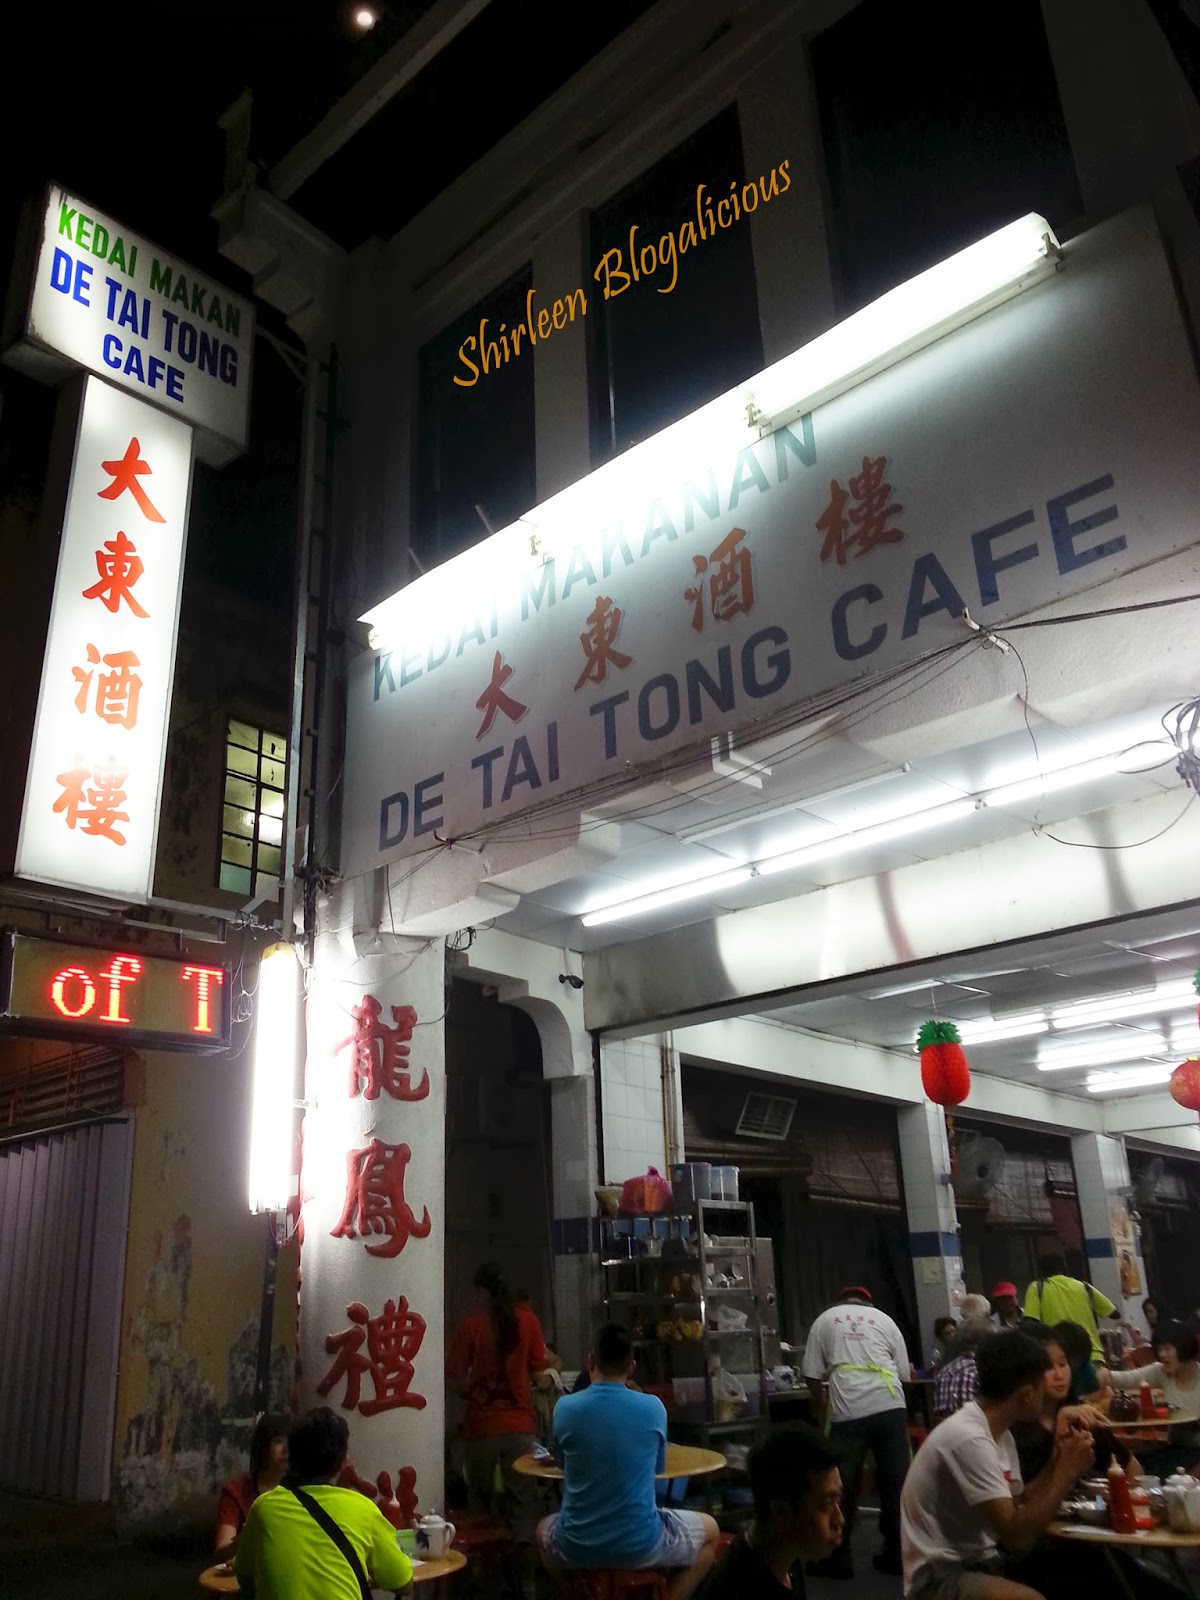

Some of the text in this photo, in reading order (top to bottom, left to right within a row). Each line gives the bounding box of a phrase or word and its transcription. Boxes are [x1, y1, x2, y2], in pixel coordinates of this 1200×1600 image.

[50, 246, 239, 388] DE TAI TONG
[58, 202, 241, 338] KEDAI MAKAN
[102, 333, 185, 404] CAFE
[51, 436, 167, 847] 大東酒樓
[373, 411, 818, 702] KEDAI MAKANAN
[379, 473, 1128, 852] DE TAI TONG CAFE
[475, 456, 905, 742] 大東酒樓
[51, 955, 142, 1025] of
[316, 993, 432, 1520] 龍鳳禮
